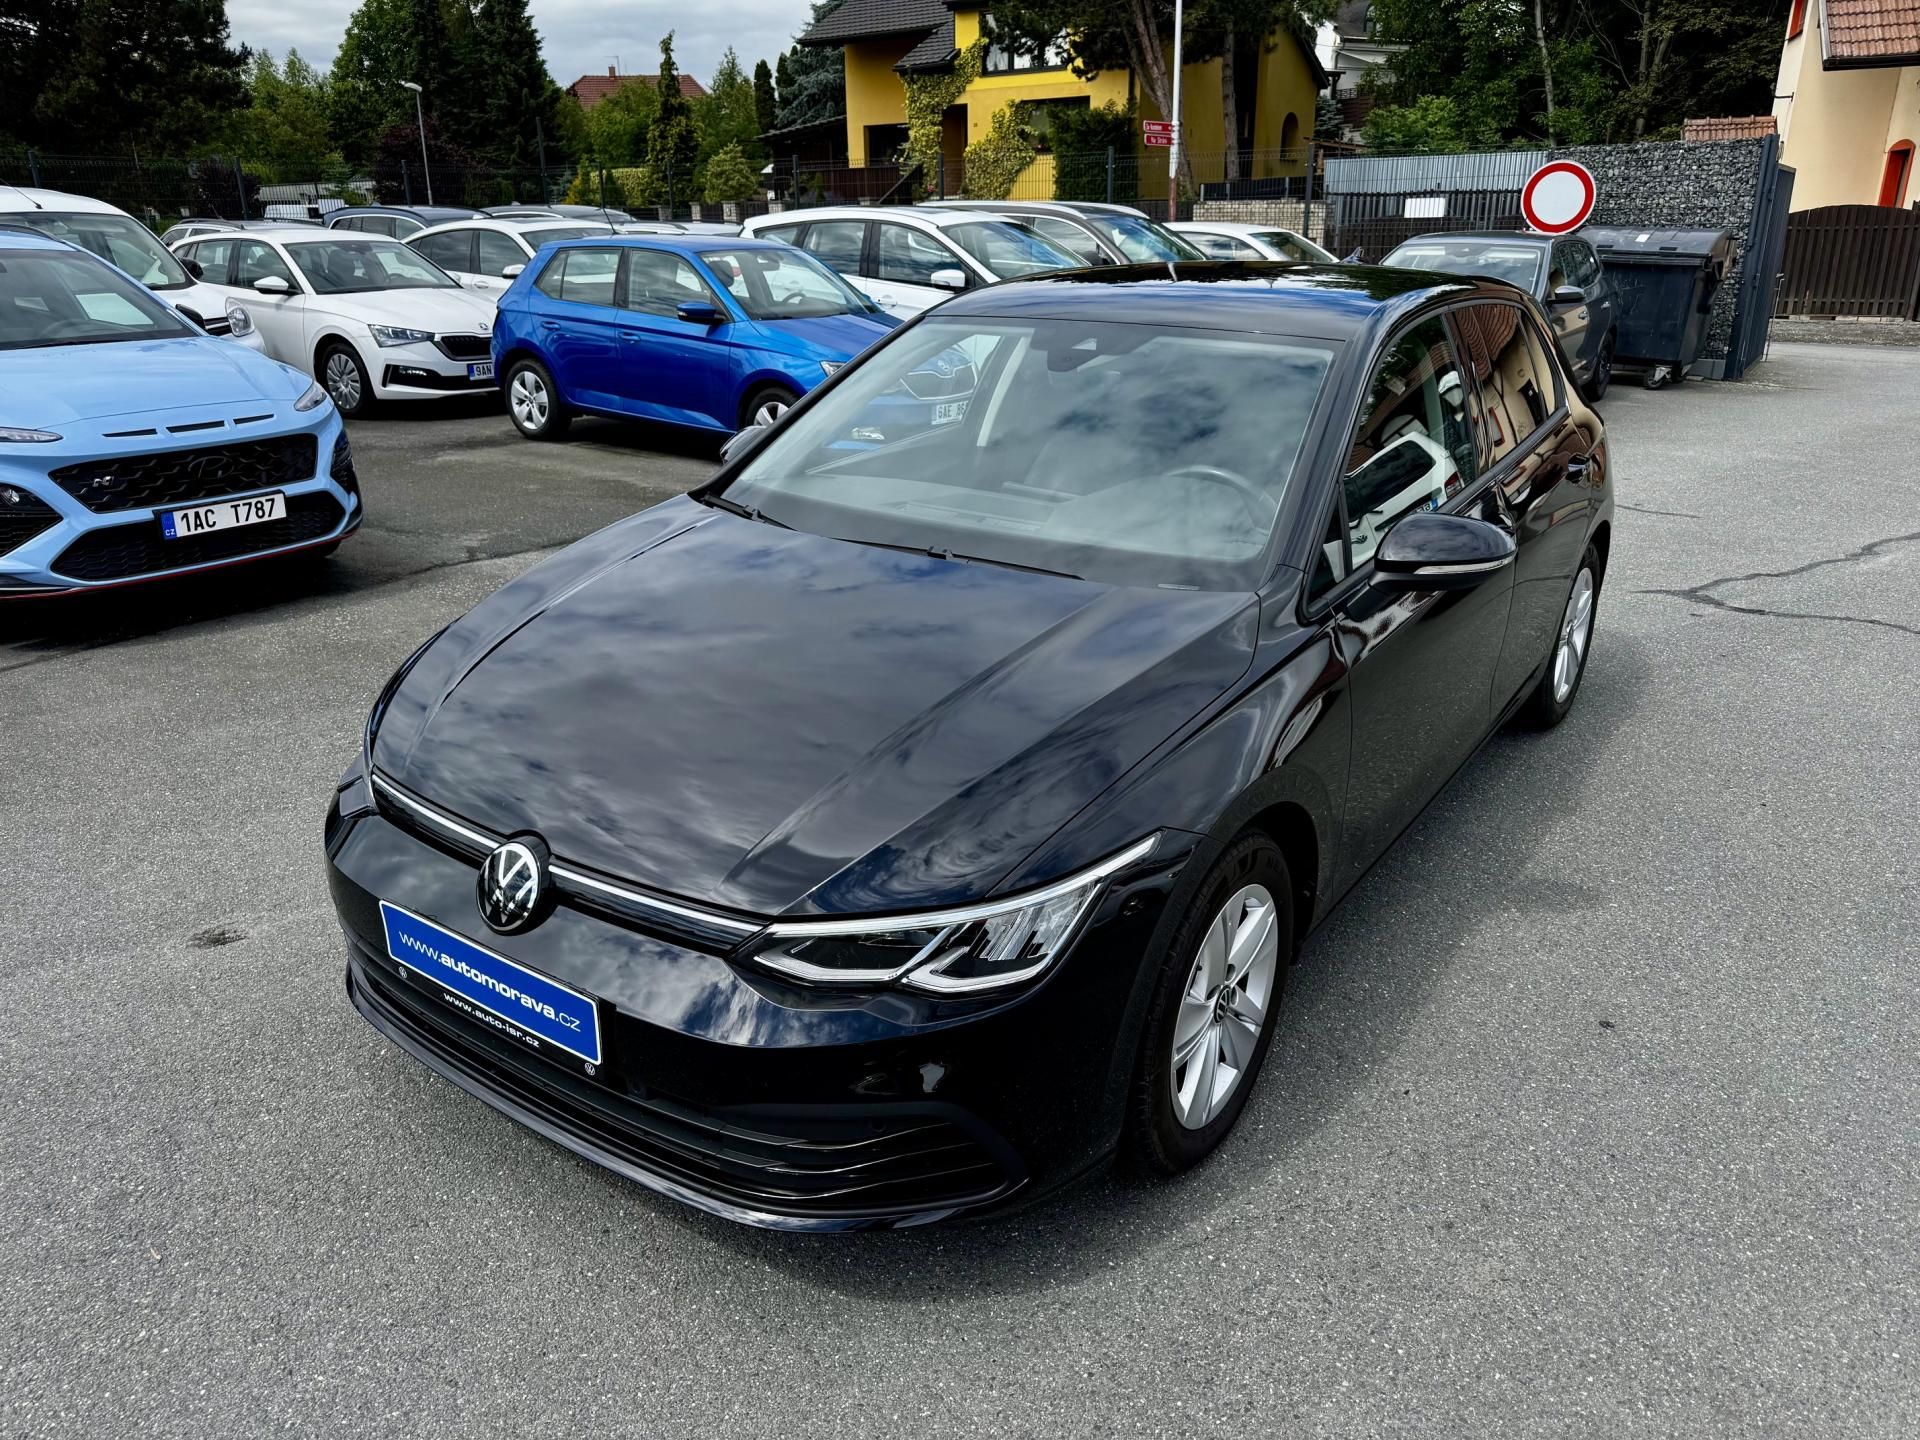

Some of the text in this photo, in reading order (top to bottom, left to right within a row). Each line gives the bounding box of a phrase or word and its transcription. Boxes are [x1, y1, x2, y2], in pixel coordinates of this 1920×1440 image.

[475, 365, 492, 376] 9AN
[938, 405, 952, 418] 6AE
[181, 498, 276, 532] 1AC T787
[165, 528, 175, 536] CZ
[399, 931, 581, 1032] www.automorava.cz
[443, 993, 540, 1048] www.auto-isr.cz
